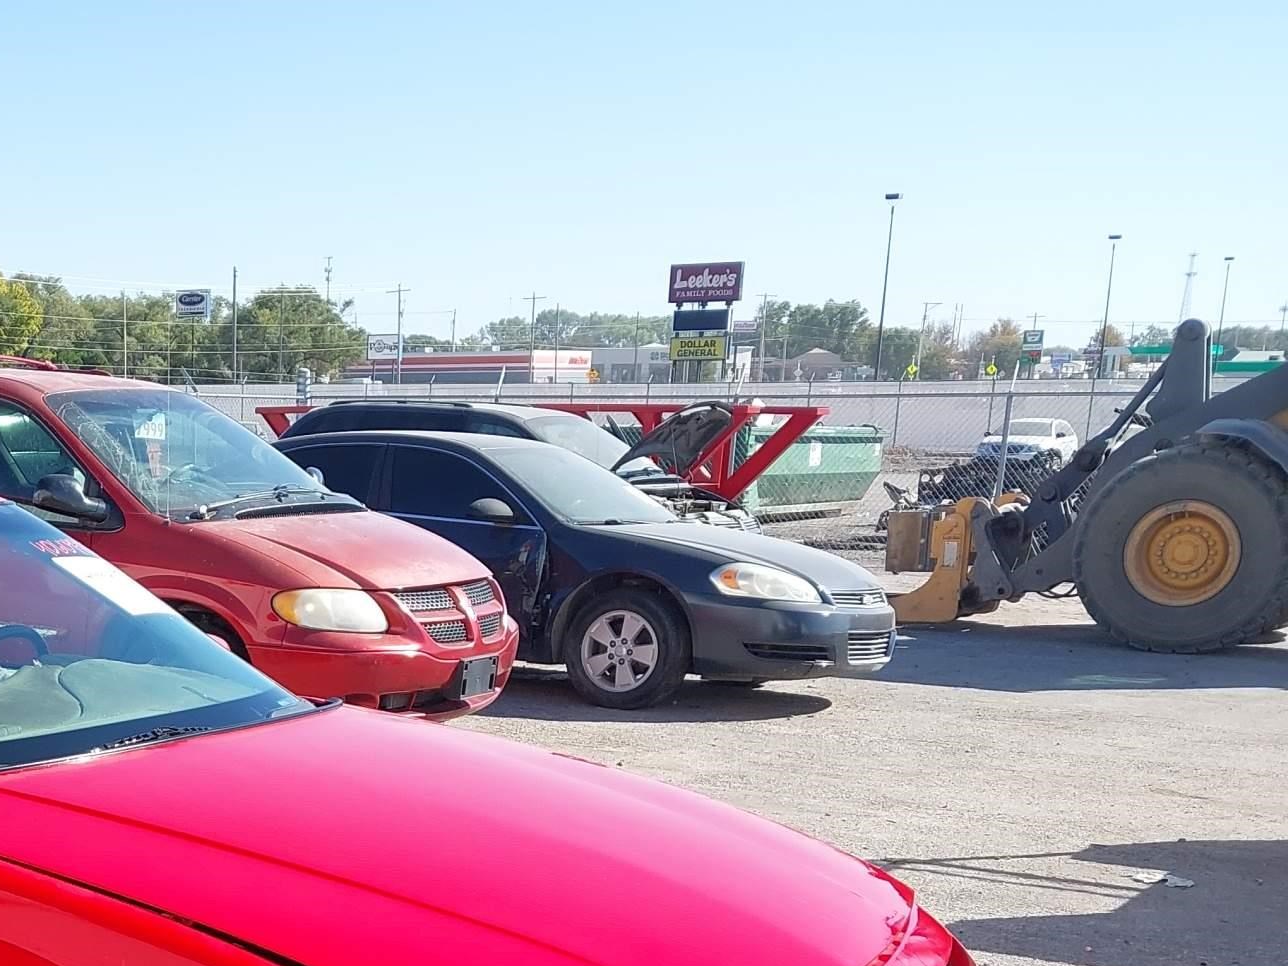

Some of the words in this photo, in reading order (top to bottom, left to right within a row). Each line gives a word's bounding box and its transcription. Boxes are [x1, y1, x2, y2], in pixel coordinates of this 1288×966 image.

[673, 268, 737, 288] Leeker's
[680, 340, 716, 348] DOLLAR
[677, 349, 718, 357] GENERAL
